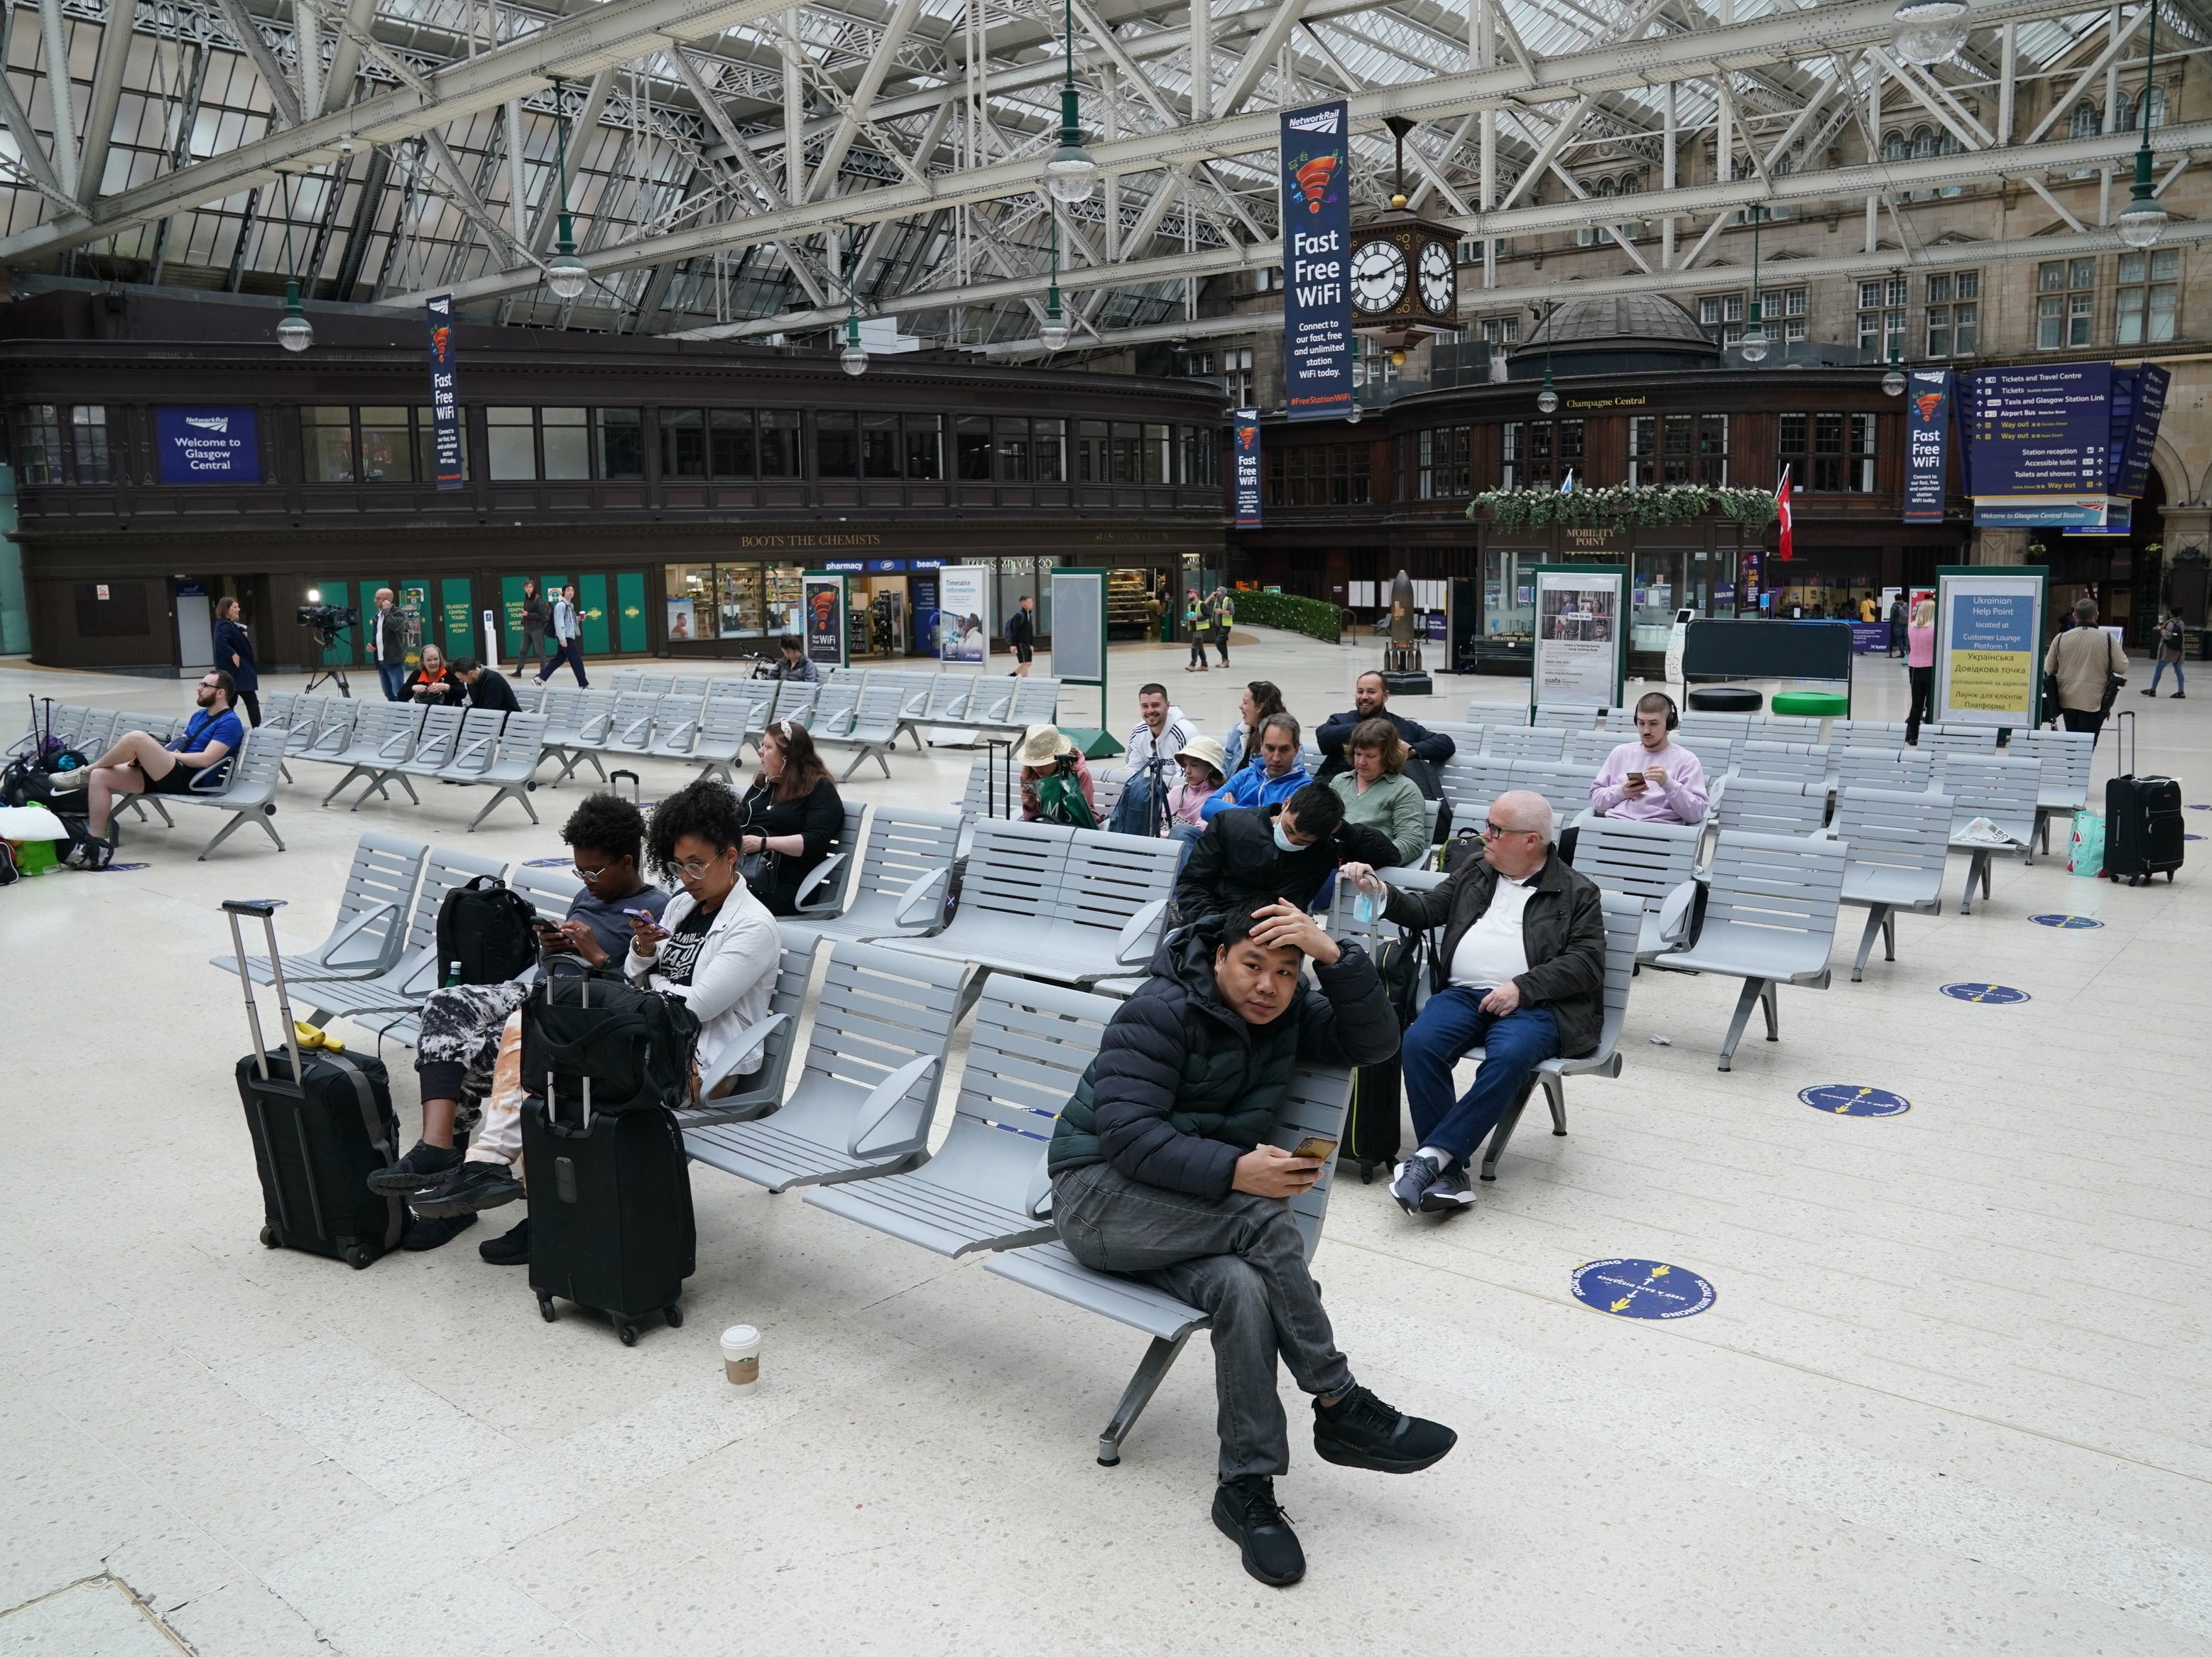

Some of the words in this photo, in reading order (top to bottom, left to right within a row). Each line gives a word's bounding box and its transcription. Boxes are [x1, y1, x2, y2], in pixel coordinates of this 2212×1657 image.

[1290, 109, 1339, 126] NetworkRail
[1295, 230, 1339, 256] Fast
[1295, 260, 1340, 283] Free
[1296, 283, 1341, 308] WiFi
[1299, 321, 1329, 331] Connect
[1295, 347, 1308, 356] and
[1309, 343, 1344, 354] unlimited
[1307, 357, 1332, 366] station
[1300, 370, 1316, 379] WiFi
[1317, 368, 1340, 377] today.
[435, 373, 452, 388] Fast
[435, 391, 453, 404] Free
[1291, 393, 1350, 405] #FreeStationWiFi
[1567, 399, 1613, 408] Champagne
[1615, 396, 1645, 406] Central
[437, 406, 454, 420] WiFi
[1913, 430, 1941, 442] Fast
[175, 438, 226, 447] Welcome
[229, 438, 241, 447] to
[185, 449, 230, 460] Glasgow
[1912, 443, 1940, 455] Free
[190, 460, 230, 469] Central
[1238, 456, 1256, 465] Fast
[1912, 457, 1939, 467] WiFi
[1238, 467, 1257, 476] Free
[1239, 477, 1257, 485] WiFi
[741, 536, 784, 547] BOOTS
[787, 536, 815, 546] THE
[819, 534, 880, 545] CHEMISTS
[1576, 538, 1606, 546] POINT
[826, 562, 863, 571] pharmacy
[1973, 608, 1991, 616] Help
[819, 634, 836, 644] WiFi
[1968, 653, 2014, 662] Українська
[1954, 664, 1999, 673] Довідкова
[1956, 691, 1980, 700] Лаунж
[1574, 1260, 1623, 1278] DISTANCING
[1596, 1275, 1635, 1287] DISTANCE
[1571, 1278, 1586, 1297] SOCIAL
[1694, 1279, 1712, 1298] SOCIAL
[1660, 1298, 1711, 1318] DISTANCING
